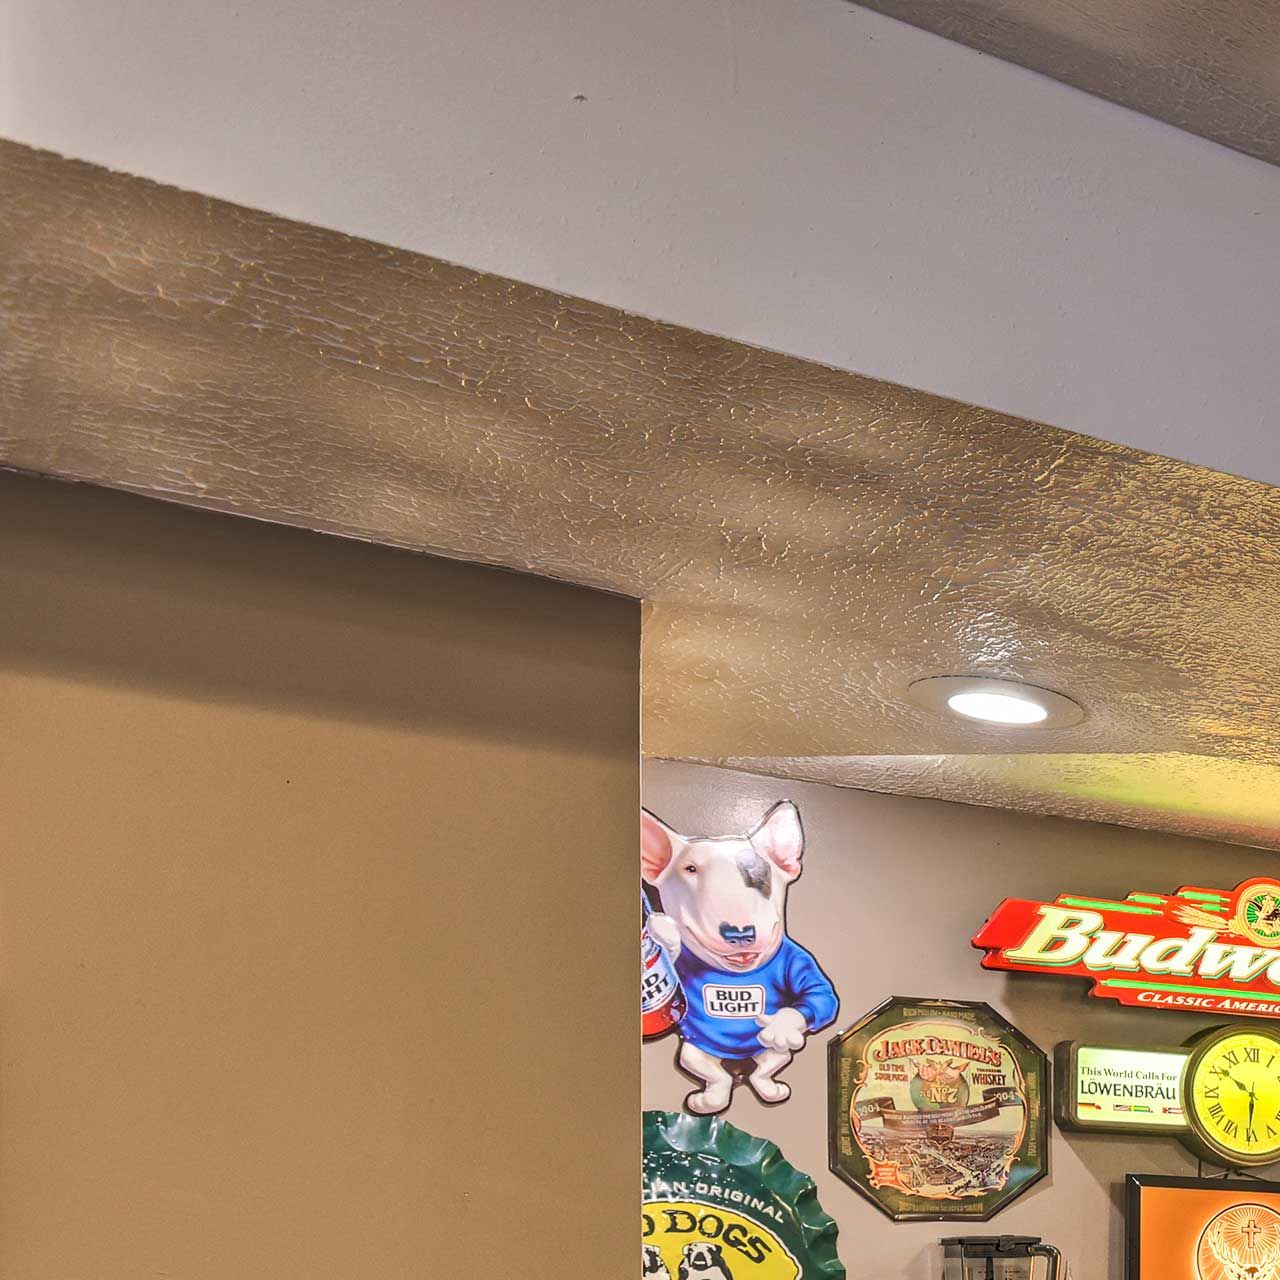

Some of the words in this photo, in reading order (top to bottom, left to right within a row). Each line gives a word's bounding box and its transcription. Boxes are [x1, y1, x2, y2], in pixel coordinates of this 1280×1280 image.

[715, 991, 752, 1001] BUD
[1137, 992, 1214, 1007] CLASSIC
[710, 1002, 759, 1012] LIGHT
[873, 1039, 924, 1062] JACK
[924, 1036, 1001, 1067] DANIEL'S
[971, 1073, 1007, 1086] WHISKEY
[1080, 1066, 1102, 1076] This
[1103, 1068, 1133, 1079] World
[1135, 1071, 1159, 1081] Calls
[1161, 1073, 1177, 1081] For
[1081, 1078, 1176, 1100] LÖWENBRÄU
[696, 1182, 784, 1224] ORIGINAL
[662, 1209, 773, 1264] DOGS
